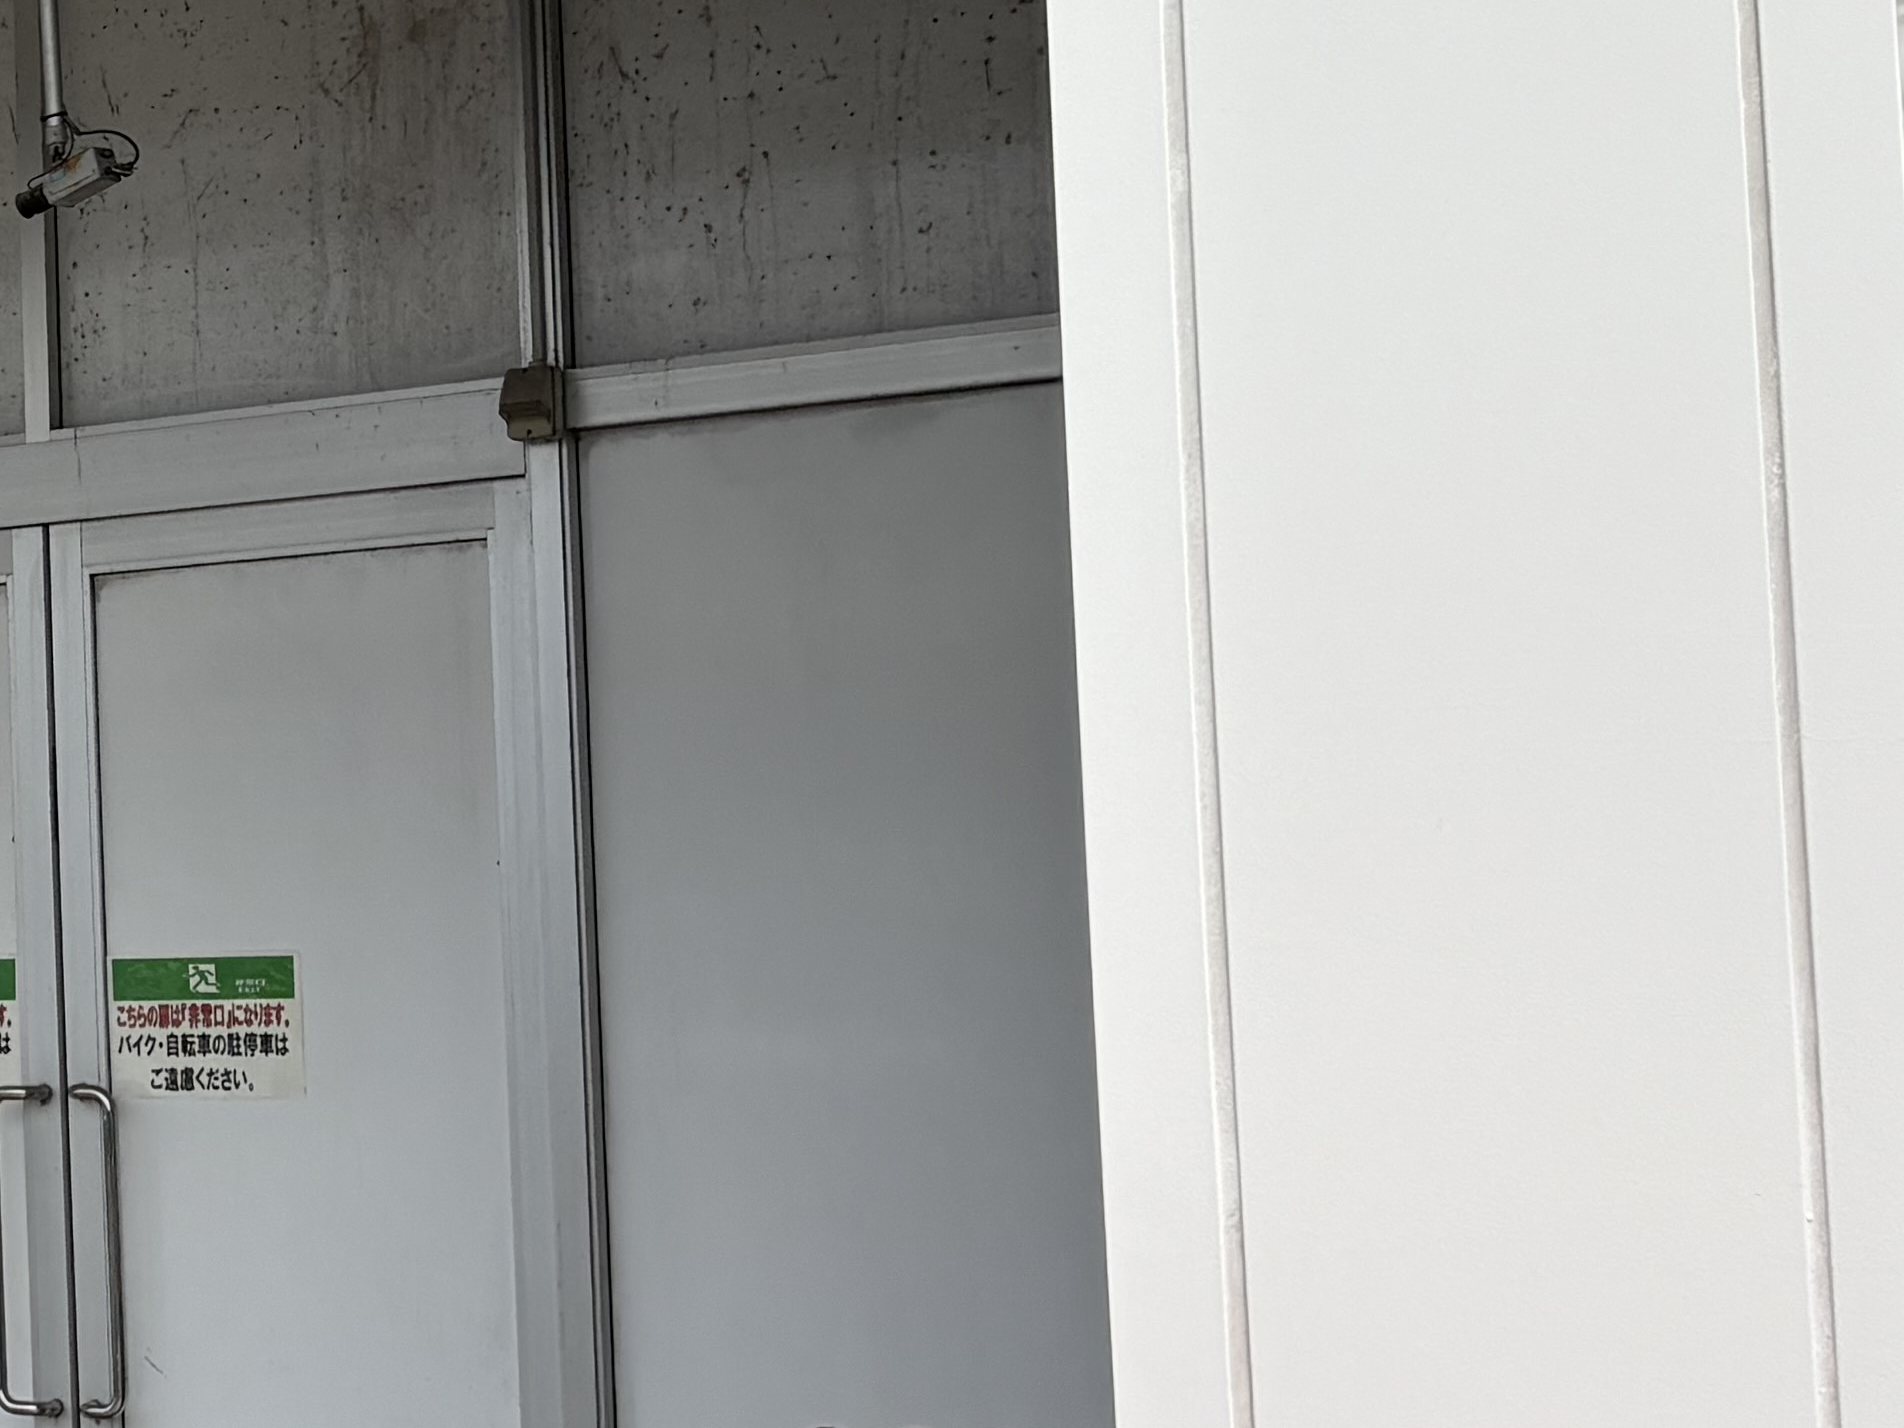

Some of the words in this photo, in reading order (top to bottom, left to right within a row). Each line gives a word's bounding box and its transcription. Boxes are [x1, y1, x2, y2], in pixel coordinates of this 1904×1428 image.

[117, 1031, 290, 1057] バイク・自転車の駐停車は
[150, 1066, 254, 1092] ご遠慮ください。
